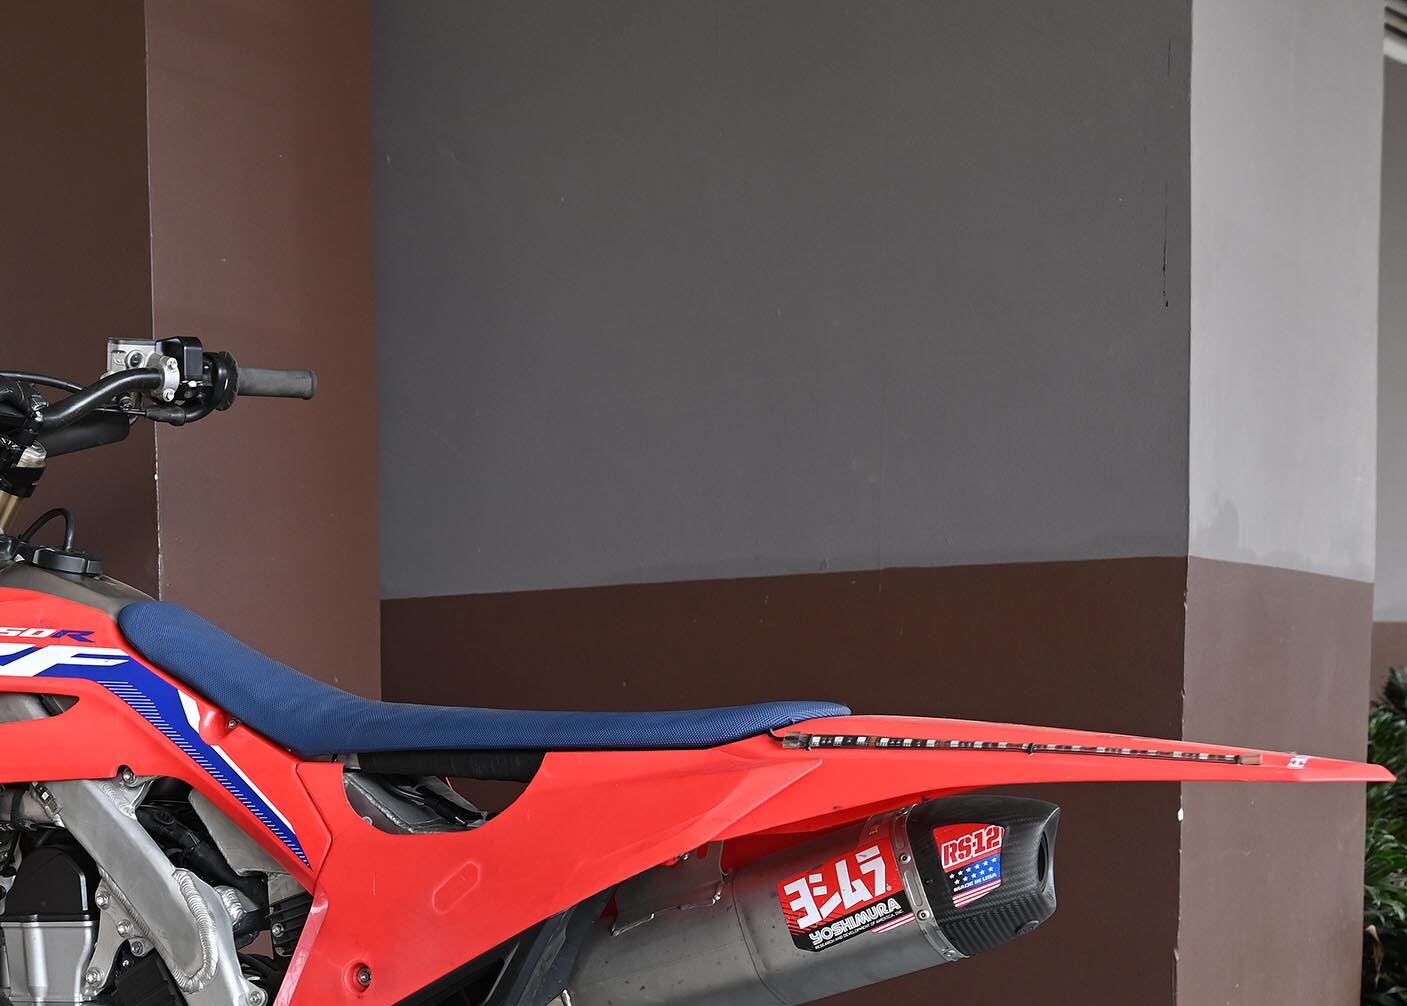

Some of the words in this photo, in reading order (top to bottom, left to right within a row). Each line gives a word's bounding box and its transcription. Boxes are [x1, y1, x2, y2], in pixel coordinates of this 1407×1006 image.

[784, 845, 887, 929] ヨシムラ
[953, 880, 974, 892] MADE
[982, 872, 997, 882] USA
[809, 898, 902, 946] YOSHIMURA
